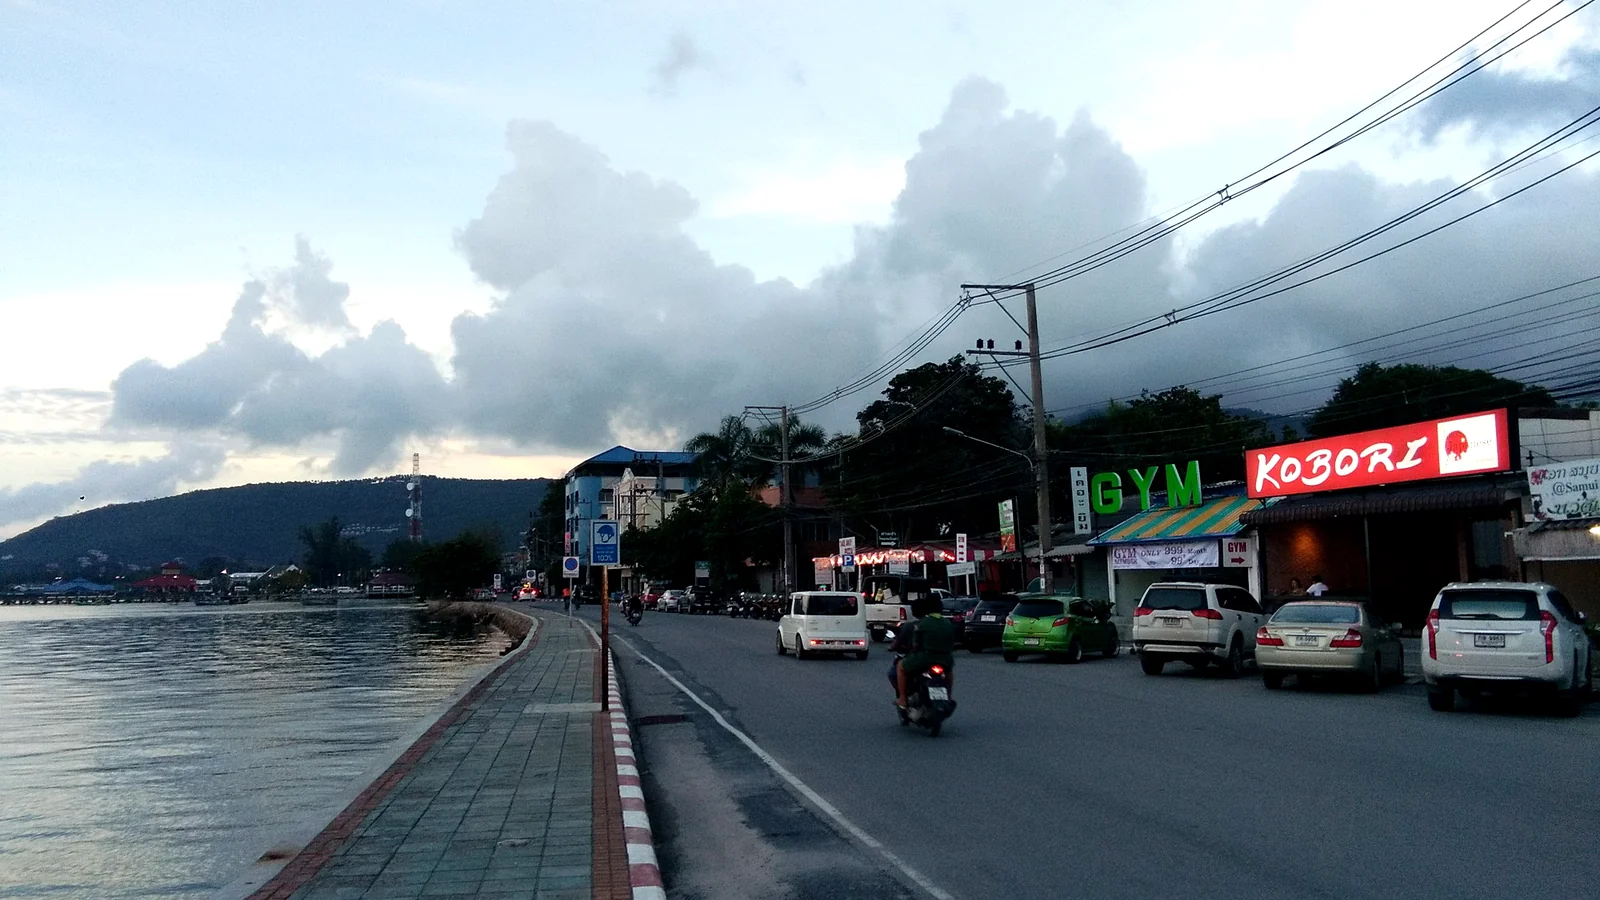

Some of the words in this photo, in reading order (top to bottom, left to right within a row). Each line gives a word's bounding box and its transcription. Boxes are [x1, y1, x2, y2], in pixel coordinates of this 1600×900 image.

[1255, 436, 1427, 492] KOBORI
[1091, 460, 1202, 514] GYM
[1552, 479, 1599, 496] @Samui
[1114, 547, 1136, 559] GYM
[1228, 542, 1247, 552] GYM
[844, 556, 852, 566] P
